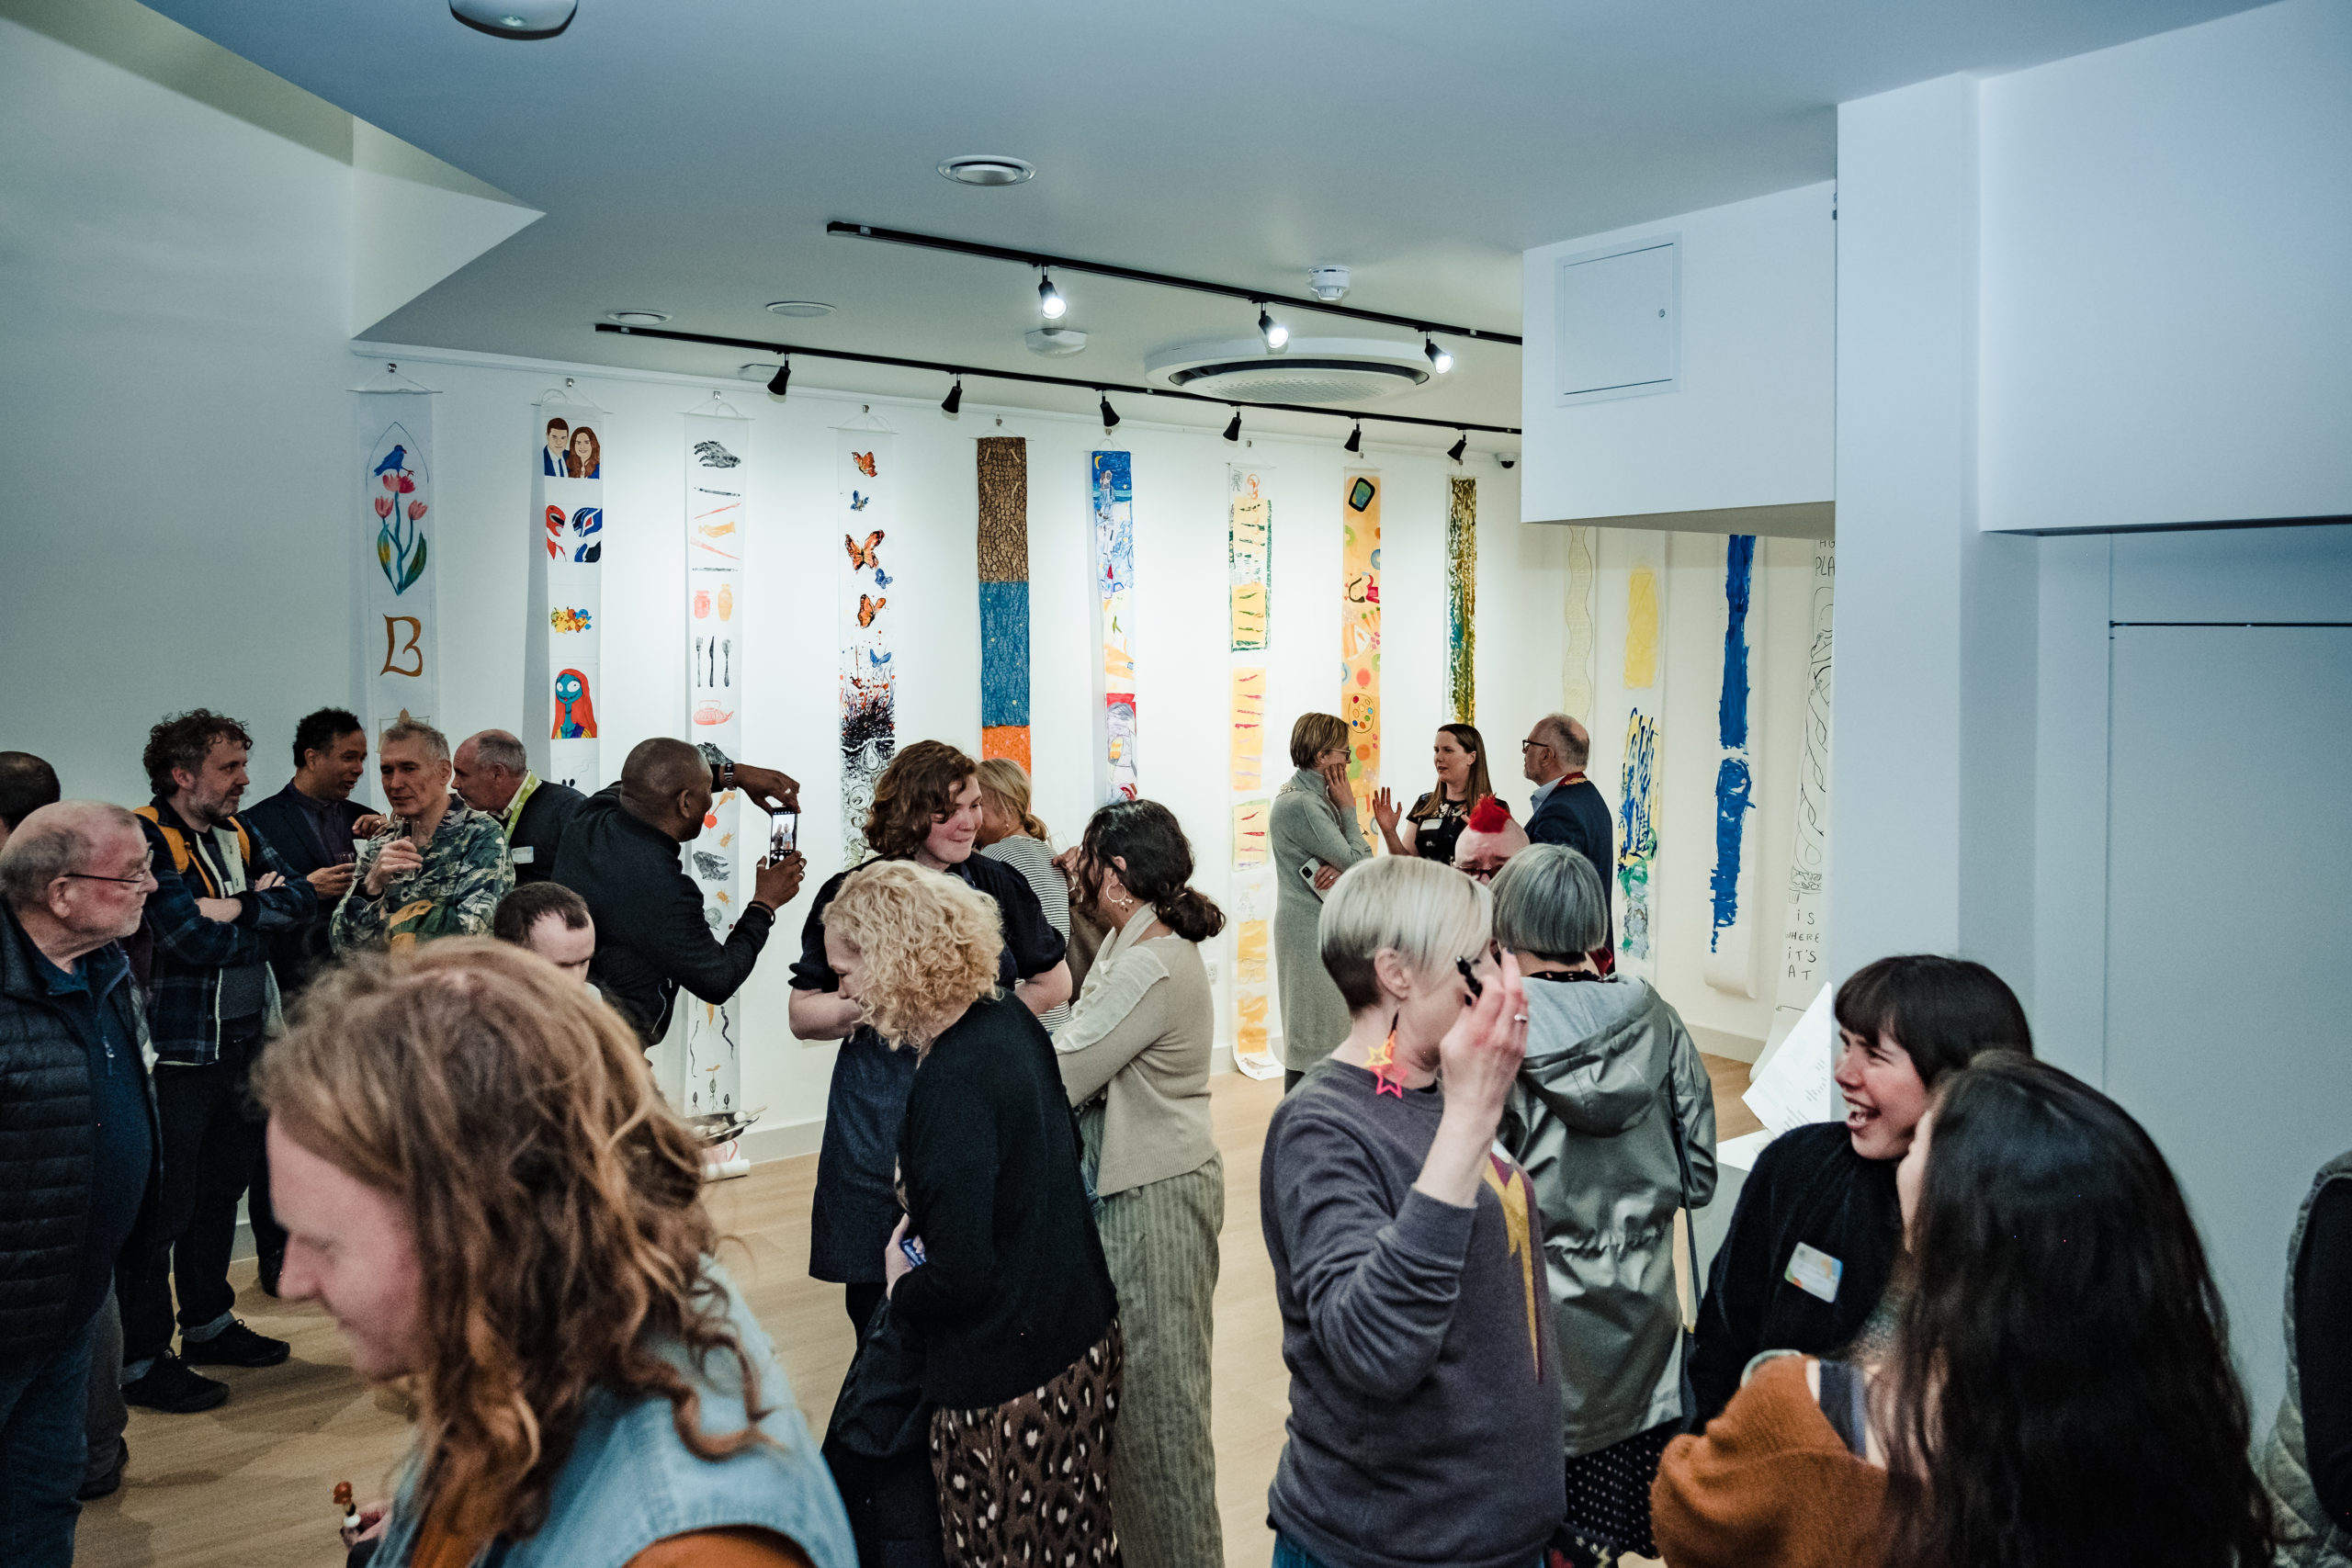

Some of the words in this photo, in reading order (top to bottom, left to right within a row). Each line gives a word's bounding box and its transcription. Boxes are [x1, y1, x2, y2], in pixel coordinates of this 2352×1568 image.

[379, 613, 423, 677] B
[1785, 931, 1820, 943] WHERE
[1788, 964, 1812, 981] AT
